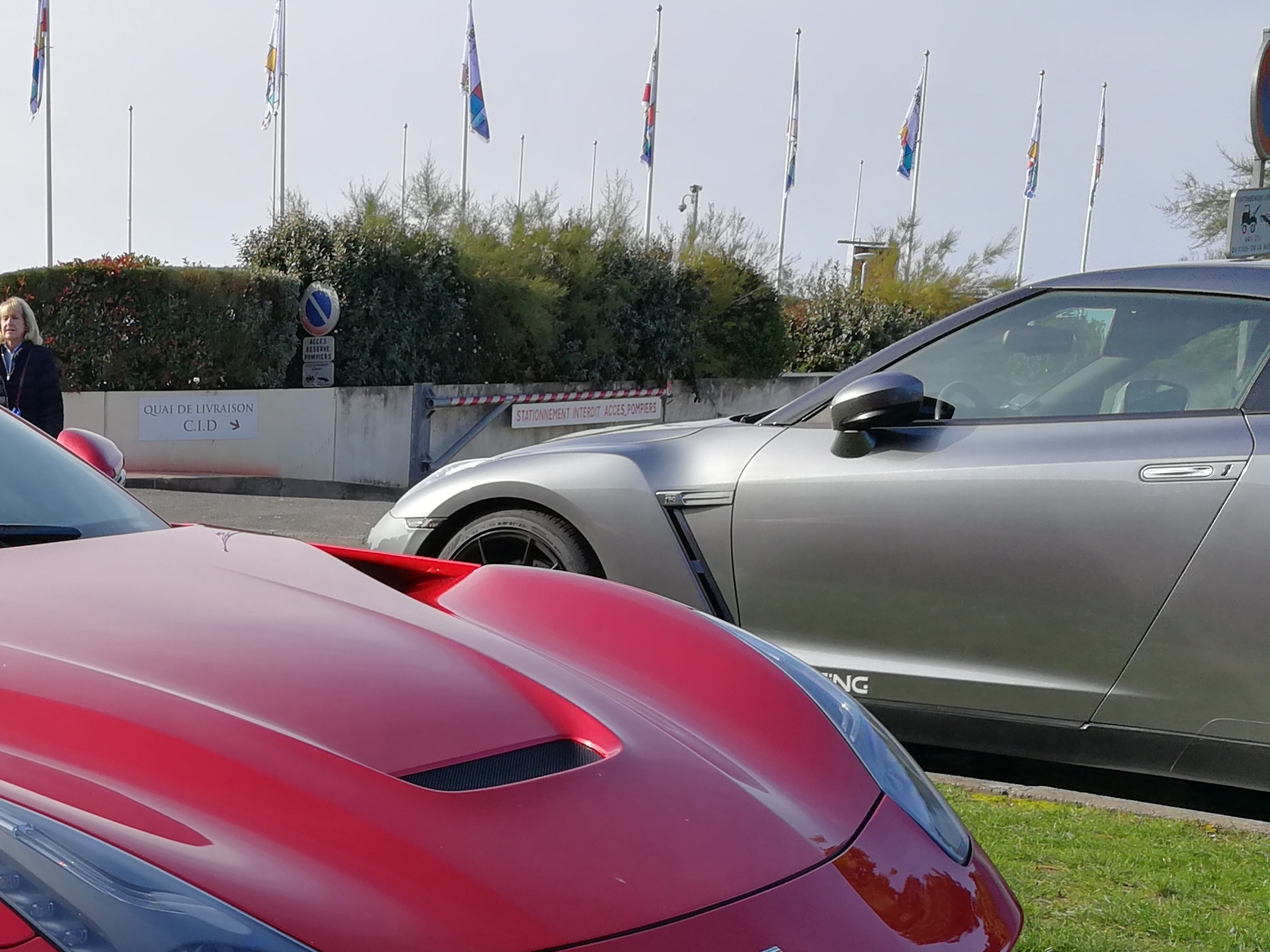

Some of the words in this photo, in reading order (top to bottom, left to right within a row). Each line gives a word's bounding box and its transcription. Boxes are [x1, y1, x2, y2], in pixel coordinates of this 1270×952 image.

[306, 345, 330, 353] RESERVE
[143, 404, 173, 417] QUAI
[177, 404, 193, 414] DE
[196, 403, 254, 414] LIVRAISON
[516, 407, 571, 422] STATIONNEMENT
[572, 405, 601, 419] INTERDIT
[183, 419, 218, 432] C.I.D
